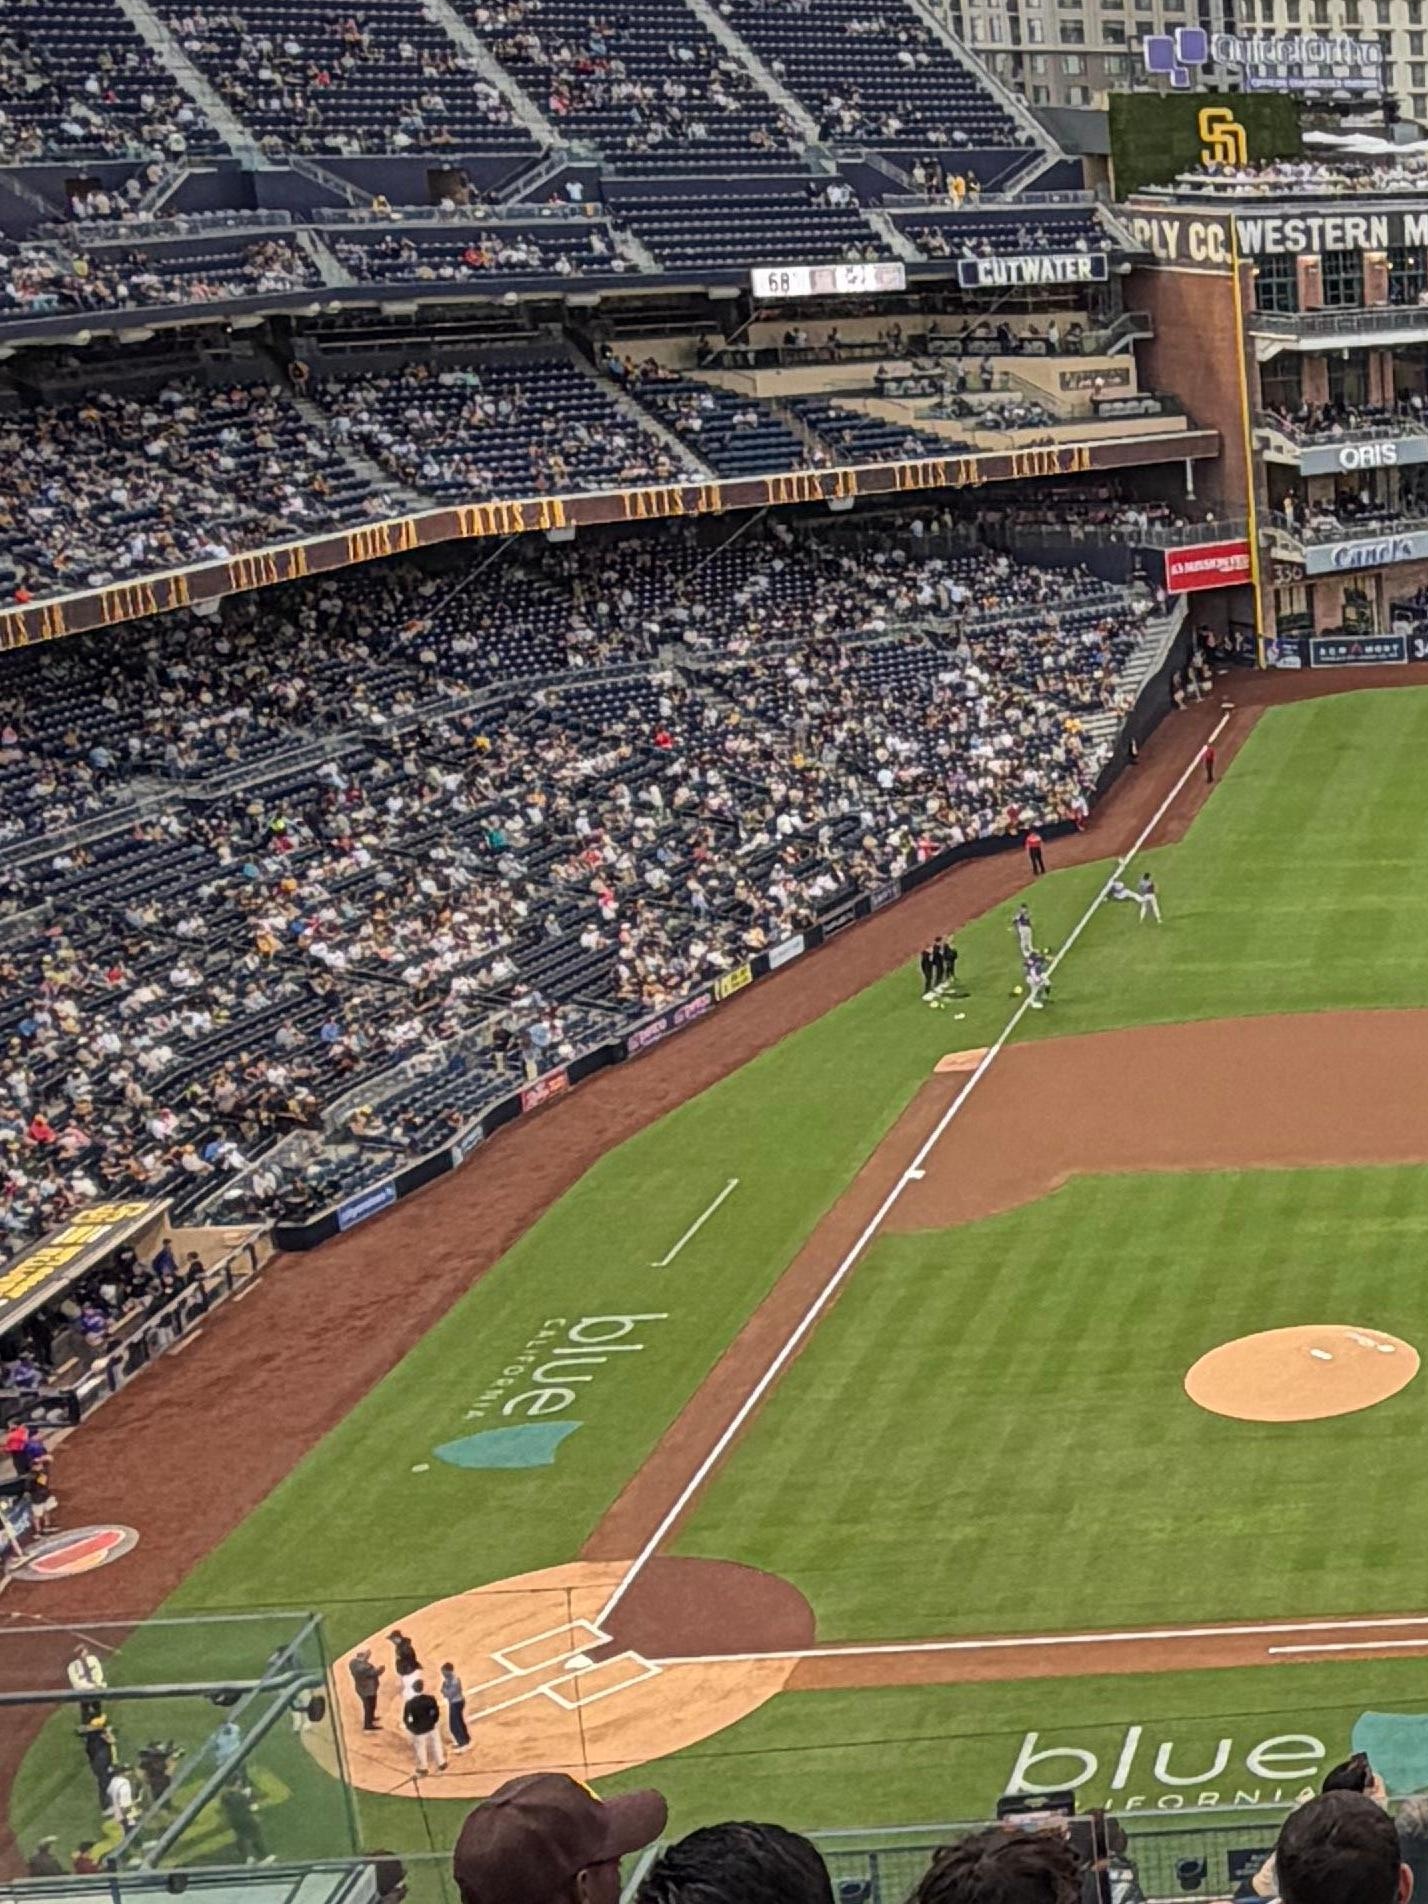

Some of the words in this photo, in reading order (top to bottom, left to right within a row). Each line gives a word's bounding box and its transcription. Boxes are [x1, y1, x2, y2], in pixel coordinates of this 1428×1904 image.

[1236, 216, 1389, 256] WESTERN
[978, 254, 1093, 284] CUTWATER
[1339, 444, 1397, 470] ORIS
[502, 1312, 669, 1417] blue
[1004, 1725, 1326, 1795] blue
